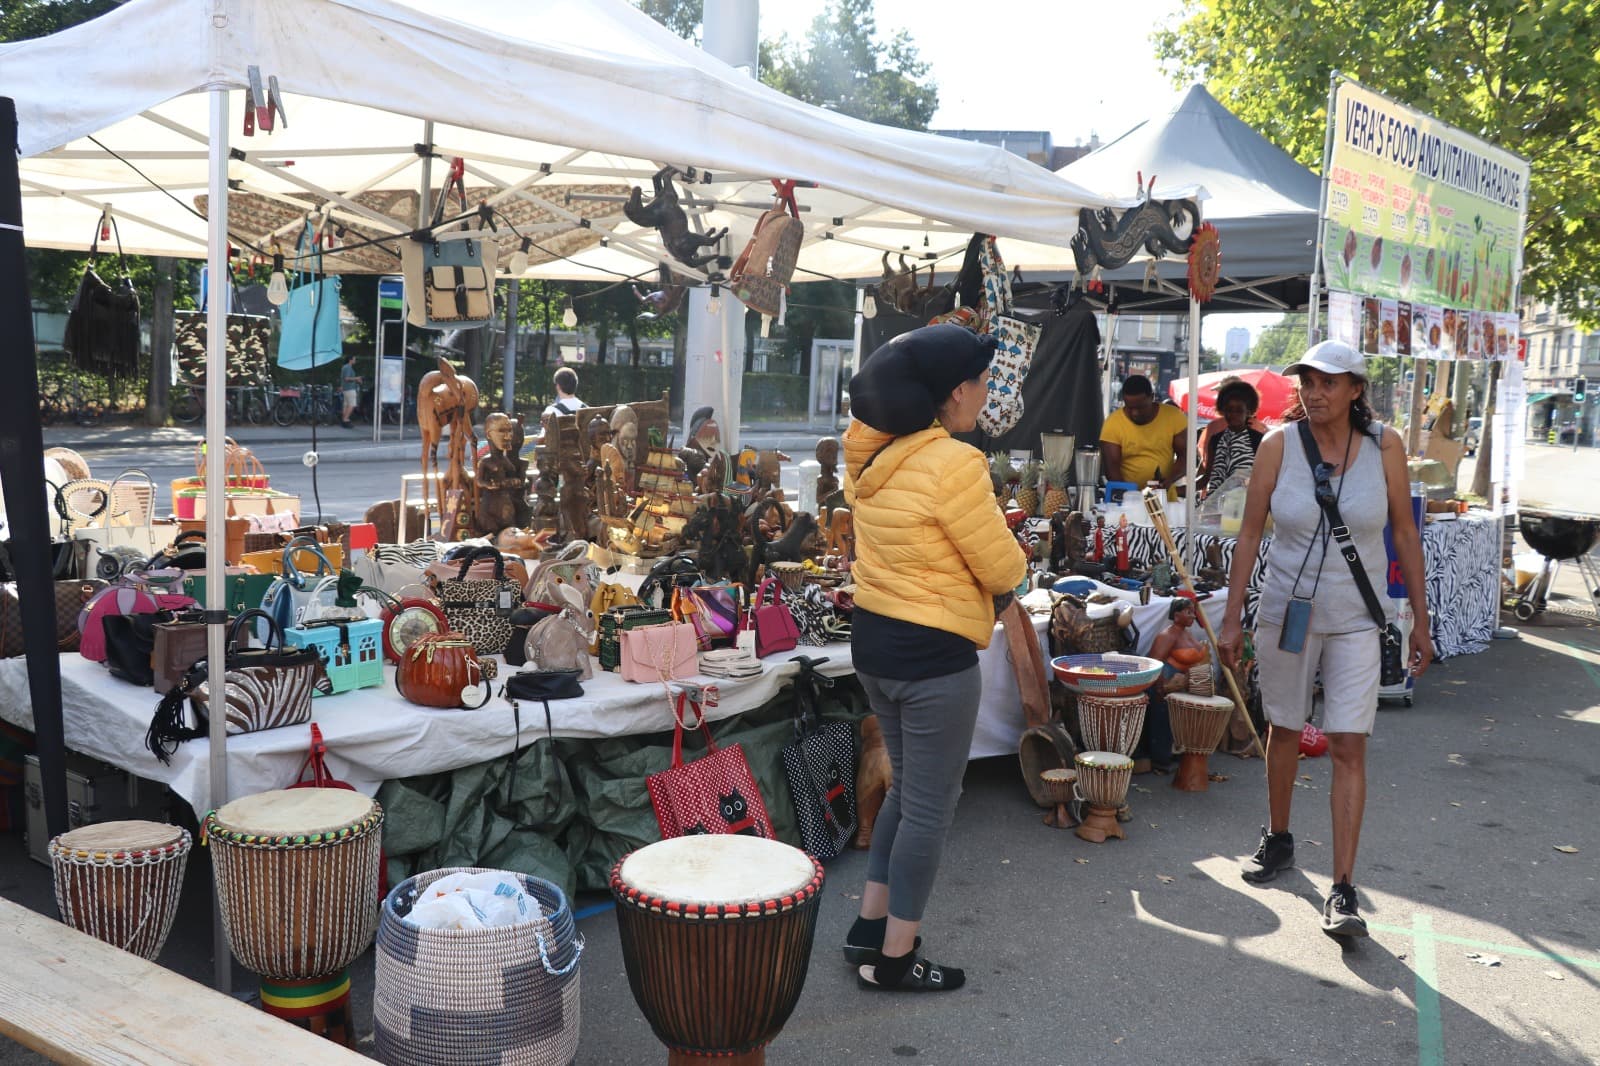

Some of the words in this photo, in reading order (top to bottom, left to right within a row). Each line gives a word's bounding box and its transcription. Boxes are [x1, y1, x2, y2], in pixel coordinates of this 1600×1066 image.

[1345, 98, 1387, 156] VERA'S
[1386, 117, 1418, 168] FOOD
[1417, 132, 1441, 178] AND
[1441, 141, 1480, 194] VITAMIN
[1481, 157, 1521, 208] PARADISE
